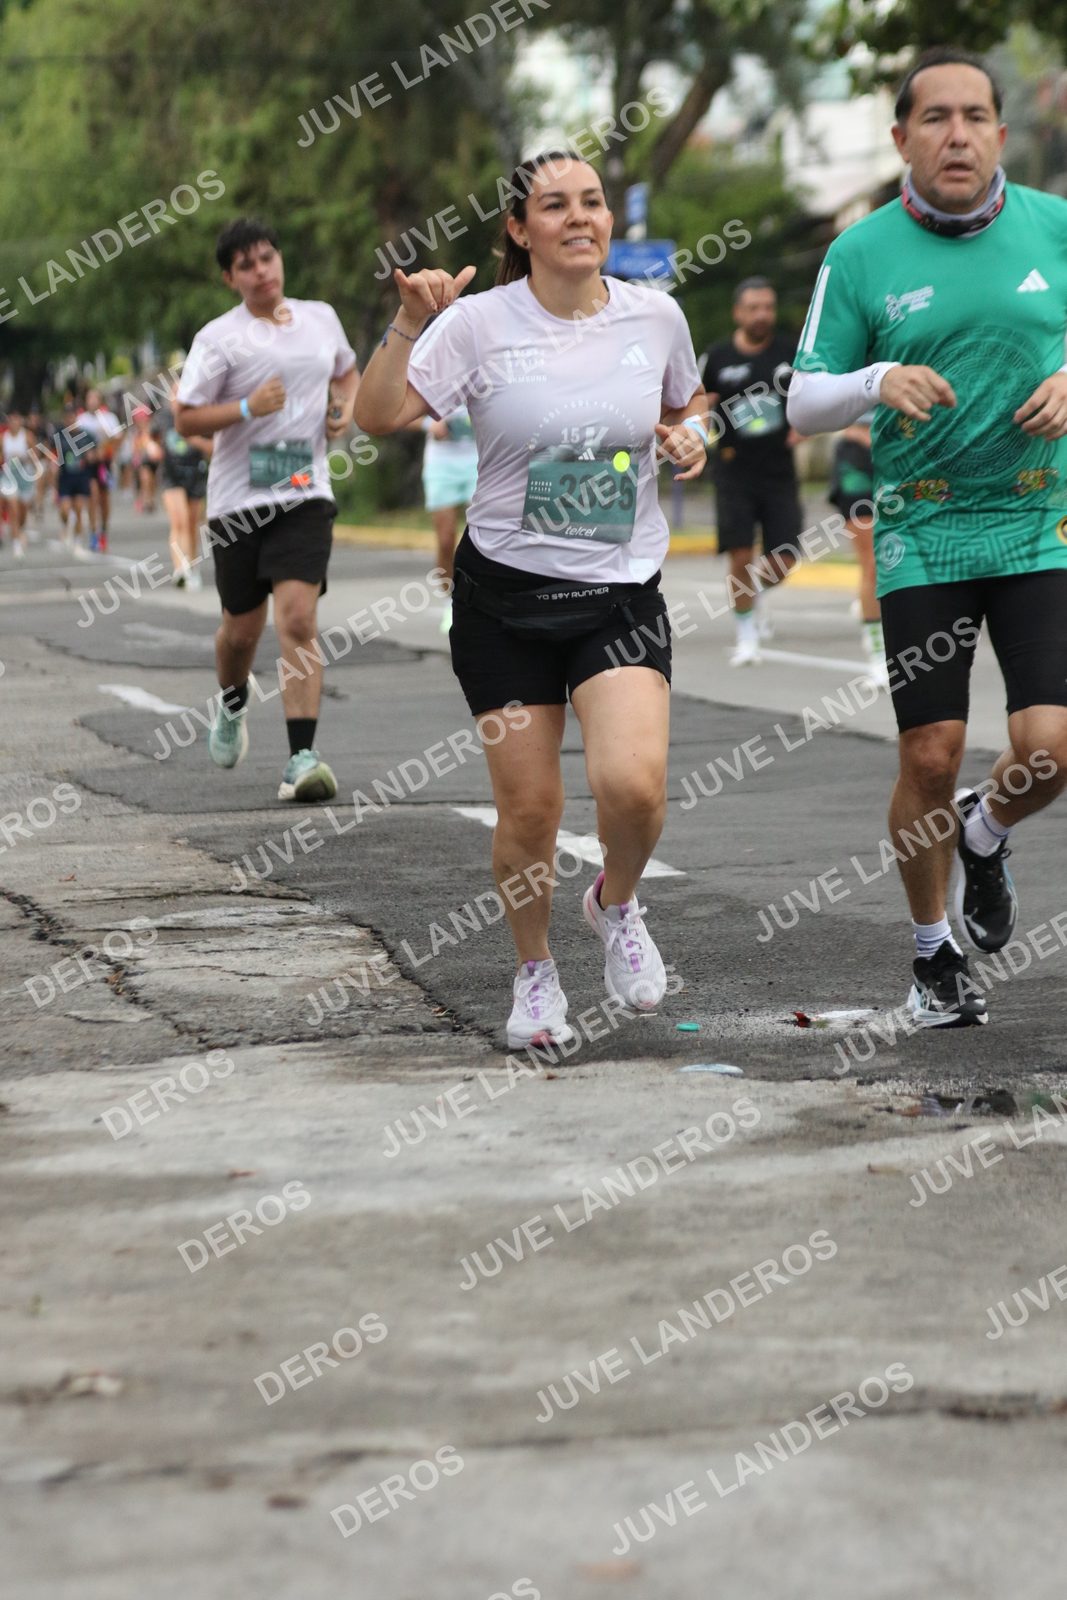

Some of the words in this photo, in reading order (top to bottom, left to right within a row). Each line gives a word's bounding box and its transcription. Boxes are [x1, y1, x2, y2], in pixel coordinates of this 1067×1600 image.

[561, 427, 580, 443] 15
[565, 525, 597, 537] telcel
[571, 586, 610, 599] RUNNER
